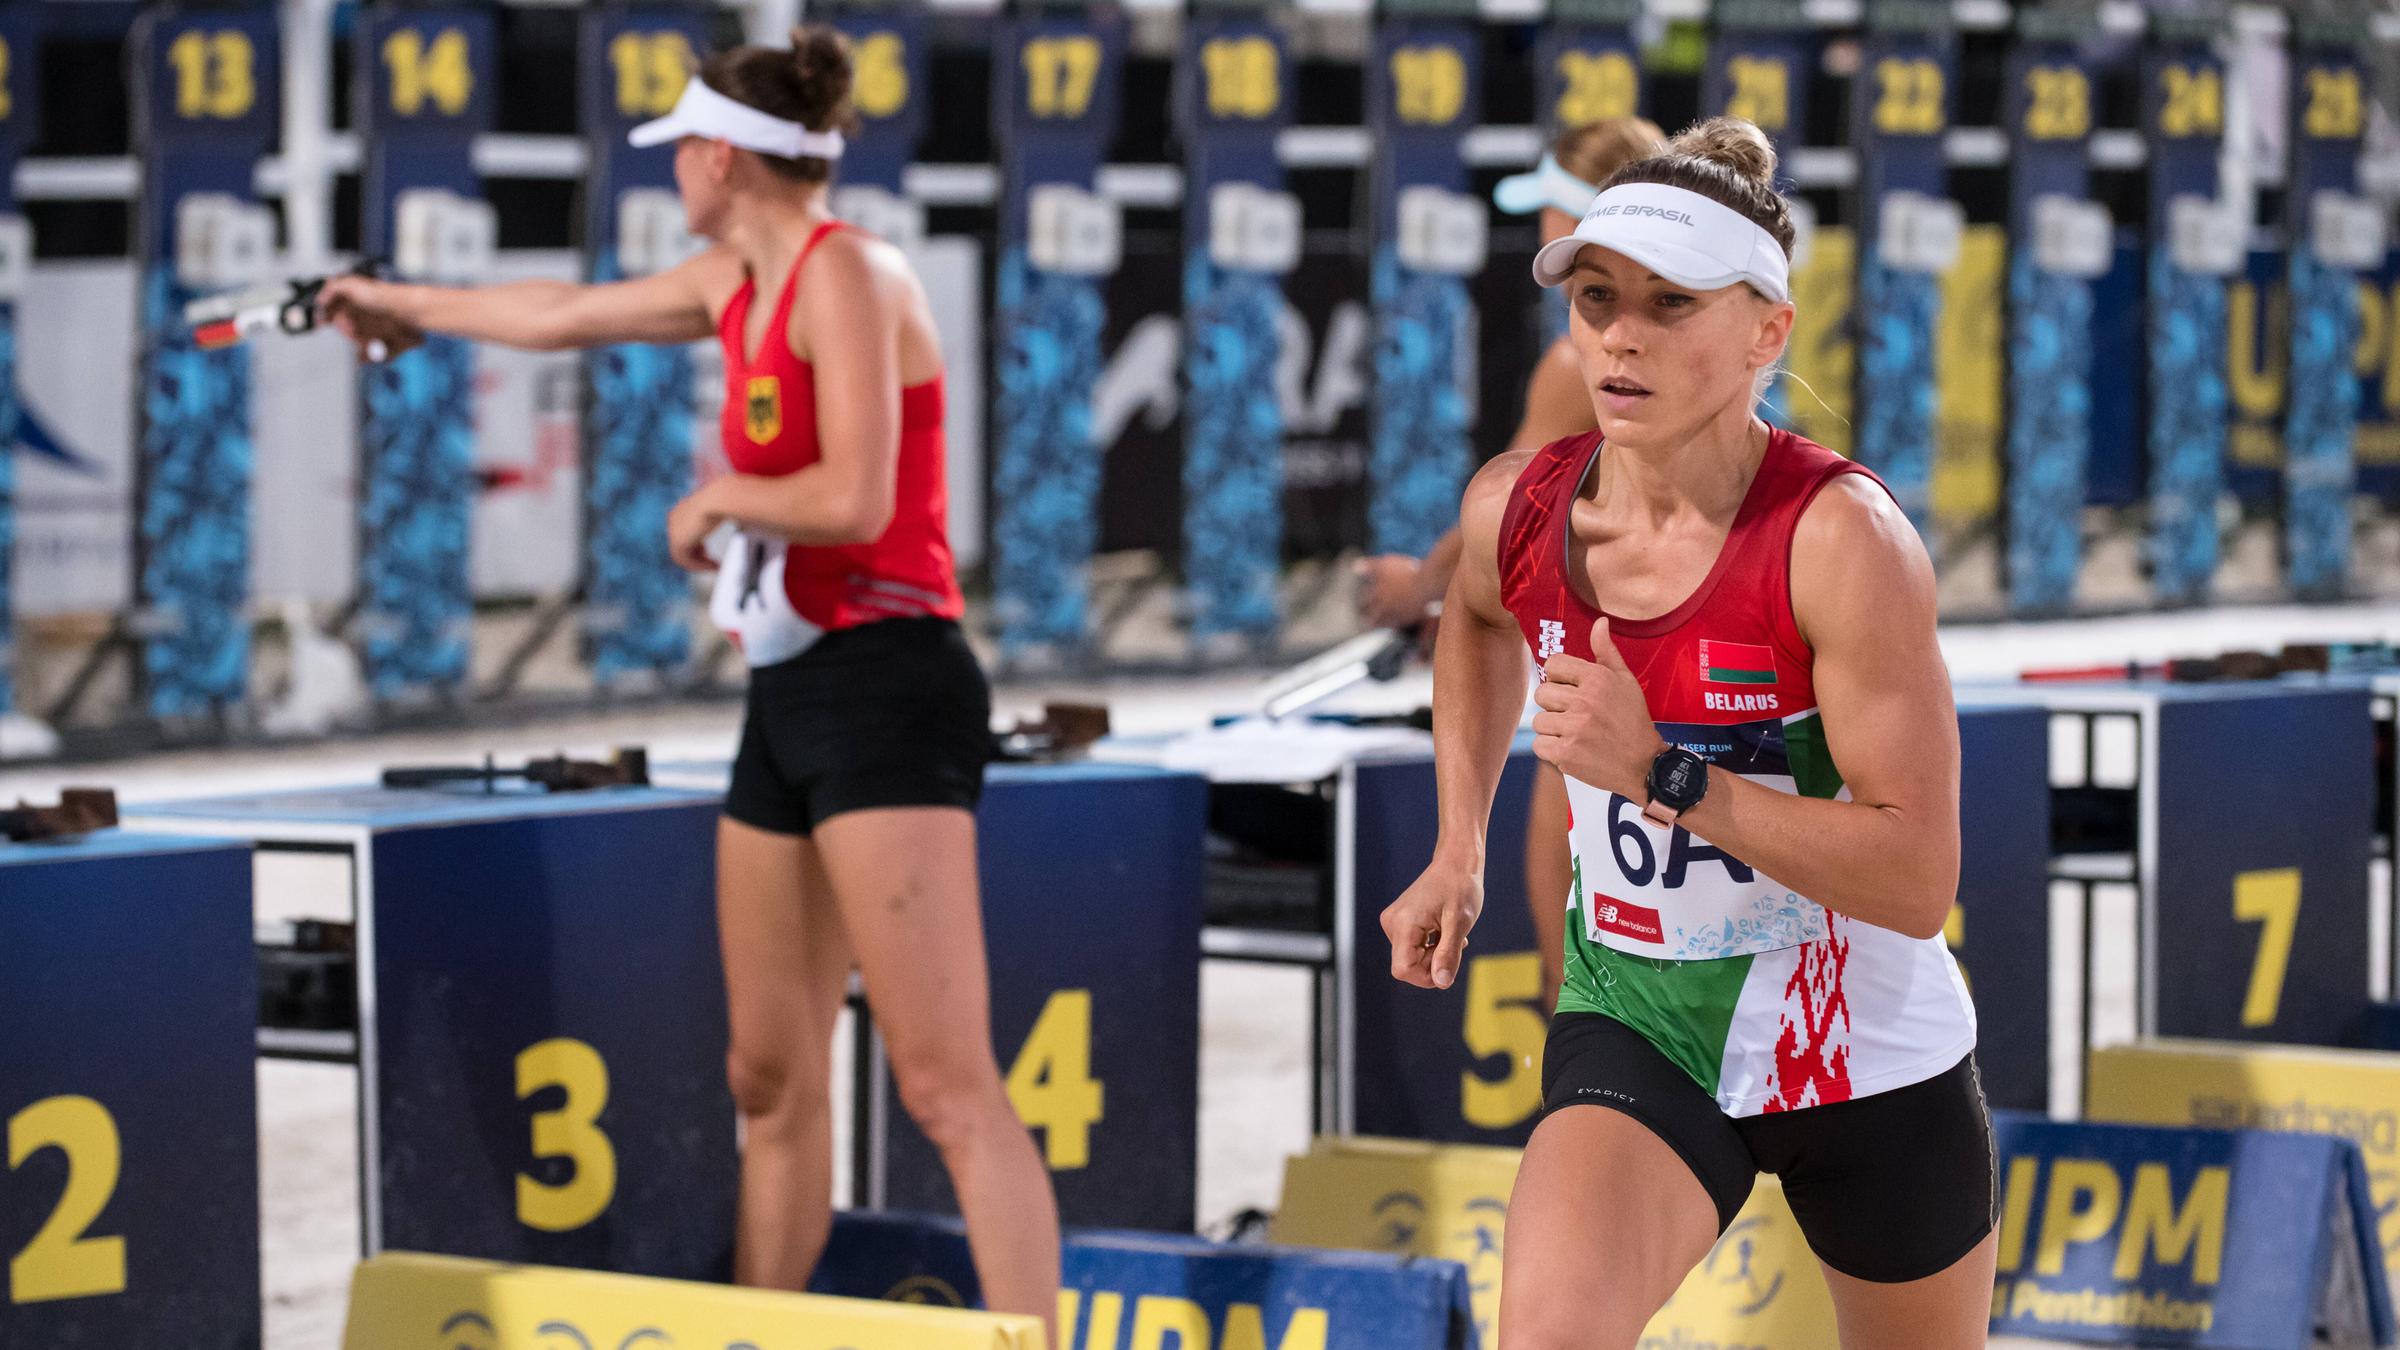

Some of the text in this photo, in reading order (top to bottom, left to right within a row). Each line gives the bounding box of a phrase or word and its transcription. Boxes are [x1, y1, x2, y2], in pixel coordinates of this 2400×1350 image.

[170, 32, 255, 118] 13
[384, 31, 472, 115] 14
[850, 33, 908, 117] 6
[1024, 38, 1099, 116] 17
[1202, 38, 1279, 117] 18
[1391, 48, 1465, 124] 19
[1556, 52, 1637, 124] 20
[1875, 58, 1945, 134] 22
[2024, 67, 2090, 138] 23
[2160, 66, 2223, 137] 24
[1622, 205, 1695, 227] BRASIL
[1704, 692, 1779, 711] BELARUS
[1709, 744, 1733, 753] RUN
[1607, 792, 1755, 888] 6A
[2233, 867, 2301, 1027] 7
[1003, 988, 1104, 1170] 4
[1461, 951, 1549, 1130] 5
[1577, 1088, 1636, 1103] EVADICT
[514, 1037, 617, 1233] 3
[8, 1094, 126, 1303] 2
